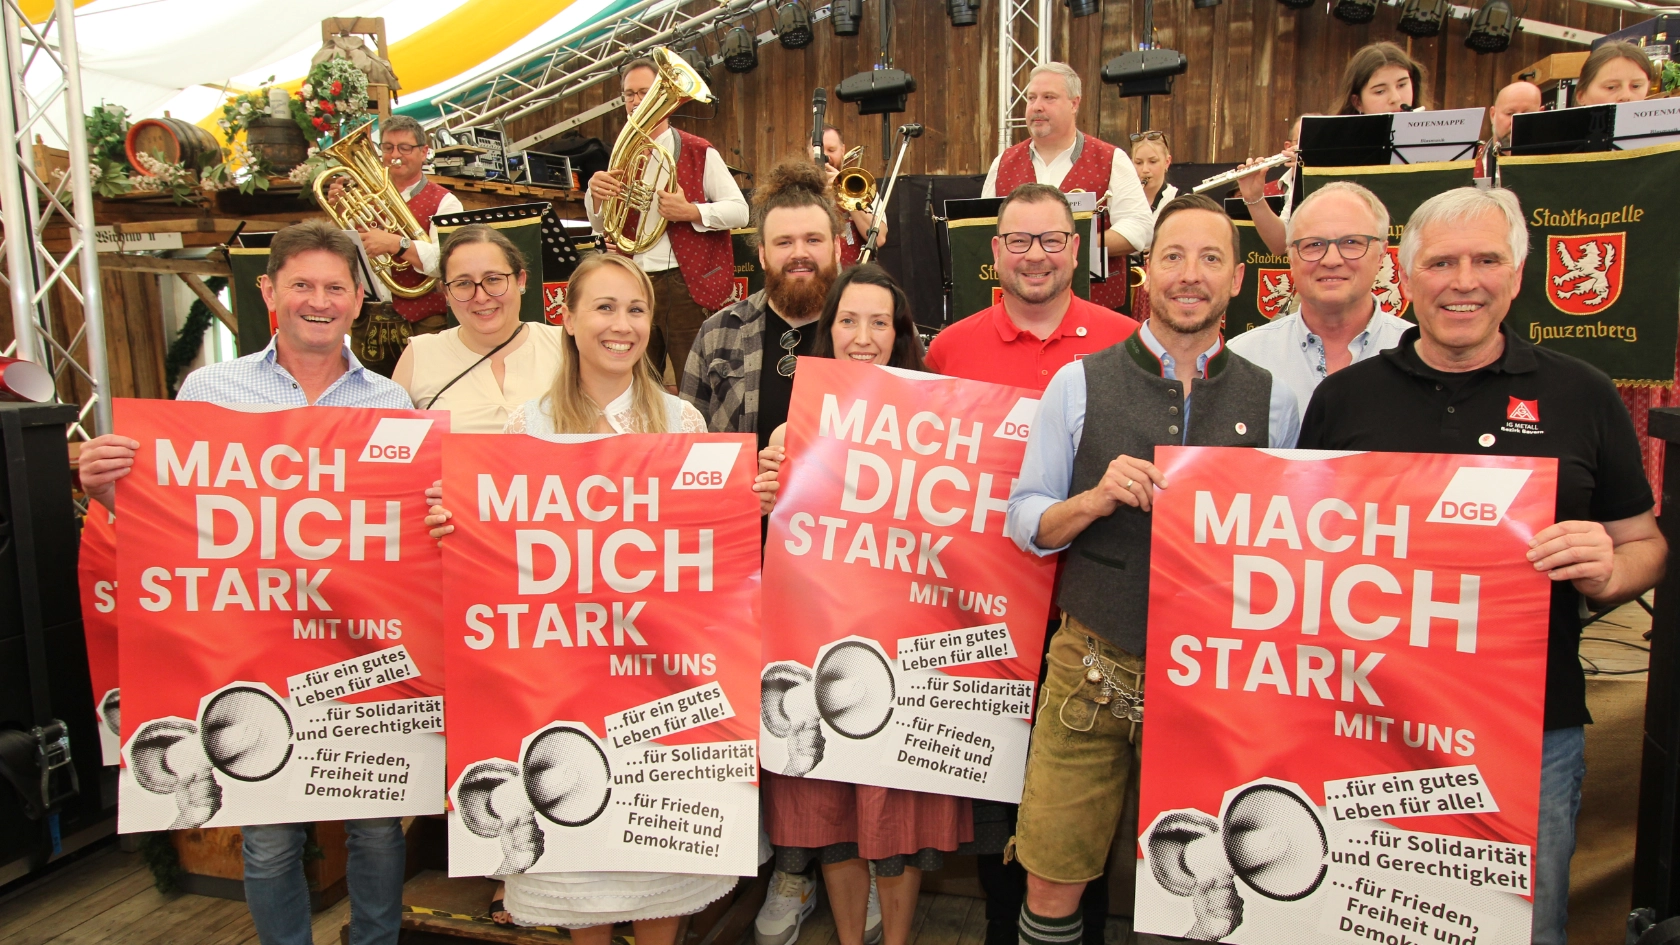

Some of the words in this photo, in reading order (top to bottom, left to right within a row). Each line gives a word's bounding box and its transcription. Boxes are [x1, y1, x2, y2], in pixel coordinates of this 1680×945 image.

[1408, 119, 1465, 128] NOTENMAPPE
[1530, 204, 1644, 229] Stadtkapelle
[734, 262, 755, 273] apelle
[1246, 251, 1289, 264] Stadtka
[1529, 320, 1638, 345] Hauzenberg
[818, 393, 983, 464] MACH
[1004, 422, 1029, 438] DG
[155, 438, 346, 492] MACH
[369, 444, 411, 460] DGB
[682, 471, 723, 486] DGB
[477, 473, 658, 522] MACH
[840, 450, 1019, 538] DICH
[1194, 490, 1410, 560] MACH
[1440, 501, 1498, 522] DGB
[196, 495, 401, 562] DICH
[784, 511, 954, 579] STARK
[516, 529, 713, 595] DICH
[139, 566, 333, 612] STARK
[909, 582, 953, 608] MIT
[957, 589, 1008, 617] UNS
[1231, 554, 1481, 654] DICH
[293, 619, 341, 639] MIT
[348, 619, 402, 640] UNS
[464, 601, 648, 650] STARK
[898, 638, 936, 654] ...für
[940, 633, 962, 647] ein
[966, 628, 1006, 647] gutes
[290, 671, 330, 692] ...für
[334, 663, 359, 678] ein
[362, 650, 406, 674] gutes
[610, 654, 655, 676] MIT
[664, 653, 716, 676] UNS
[902, 655, 947, 671] Leben
[951, 649, 972, 664] für
[976, 643, 1008, 660] alle!
[1166, 634, 1387, 707] STARK
[295, 685, 346, 707] Leben
[348, 677, 372, 692] für
[376, 664, 411, 684] alle!
[911, 677, 949, 691] ...für
[953, 680, 1032, 698] Solidarität
[309, 708, 351, 723] ...für
[356, 700, 441, 719] Solidarität
[607, 710, 646, 732] ...für
[650, 702, 674, 717] ein
[677, 687, 721, 712] gutes
[897, 695, 925, 707] und
[929, 696, 1030, 716] Gerechtigkeit
[296, 726, 328, 741] und
[332, 717, 442, 738] Gerechtigkeit
[613, 725, 661, 749] Leben
[664, 716, 687, 732] für
[691, 703, 725, 724] alle!
[896, 716, 934, 733] ...für
[936, 723, 995, 753] Frieden,
[1334, 710, 1395, 743] MIT
[1403, 720, 1476, 757] UNS
[298, 748, 341, 763] ...für
[345, 751, 411, 770] Frieden,
[626, 750, 667, 766] ...für
[671, 744, 754, 762] Solidarität
[904, 733, 961, 759] Freiheit
[964, 751, 993, 767] und
[310, 766, 374, 782] Freiheit
[378, 772, 409, 784] und
[614, 770, 644, 785] und
[649, 763, 755, 782] Gerechtigkeit
[897, 749, 988, 784] Demokratie!
[305, 783, 406, 801] Demokratie!
[1327, 781, 1376, 800] ...für
[1382, 776, 1414, 794] ein
[1419, 772, 1479, 794] gutes
[616, 793, 657, 808] ...für
[661, 797, 724, 823] Frieden,
[1333, 803, 1396, 821] Leben
[1400, 797, 1430, 815] für
[1437, 792, 1485, 812] alle!
[628, 812, 689, 833] Freiheit
[693, 824, 722, 838] und
[623, 830, 720, 858] Demokratie!
[1348, 829, 1402, 848] ...für
[1407, 835, 1527, 867] Solidarität
[1331, 851, 1370, 867] und
[1376, 853, 1528, 890] Gerechtigkeit
[1332, 877, 1386, 899] ...für
[1390, 888, 1479, 934] Frieden,
[1346, 896, 1429, 936] Freiheit
[1433, 927, 1477, 945] und
